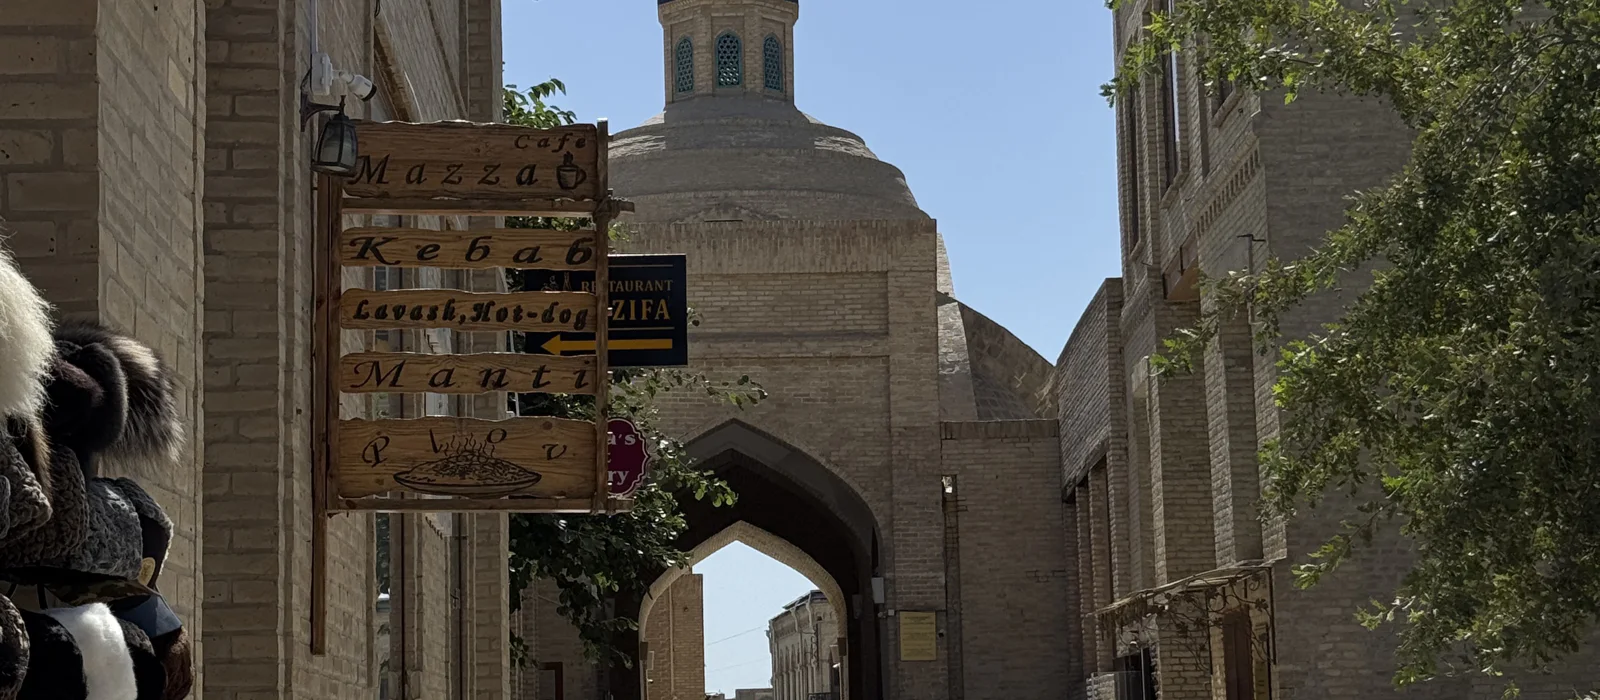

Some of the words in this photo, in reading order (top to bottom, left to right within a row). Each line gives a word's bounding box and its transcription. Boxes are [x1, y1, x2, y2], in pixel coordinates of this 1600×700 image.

[514, 132, 587, 153] Cafe
[347, 154, 539, 186] Mazza
[581, 279, 674, 293] RETAURANT
[350, 359, 590, 389] Manti
